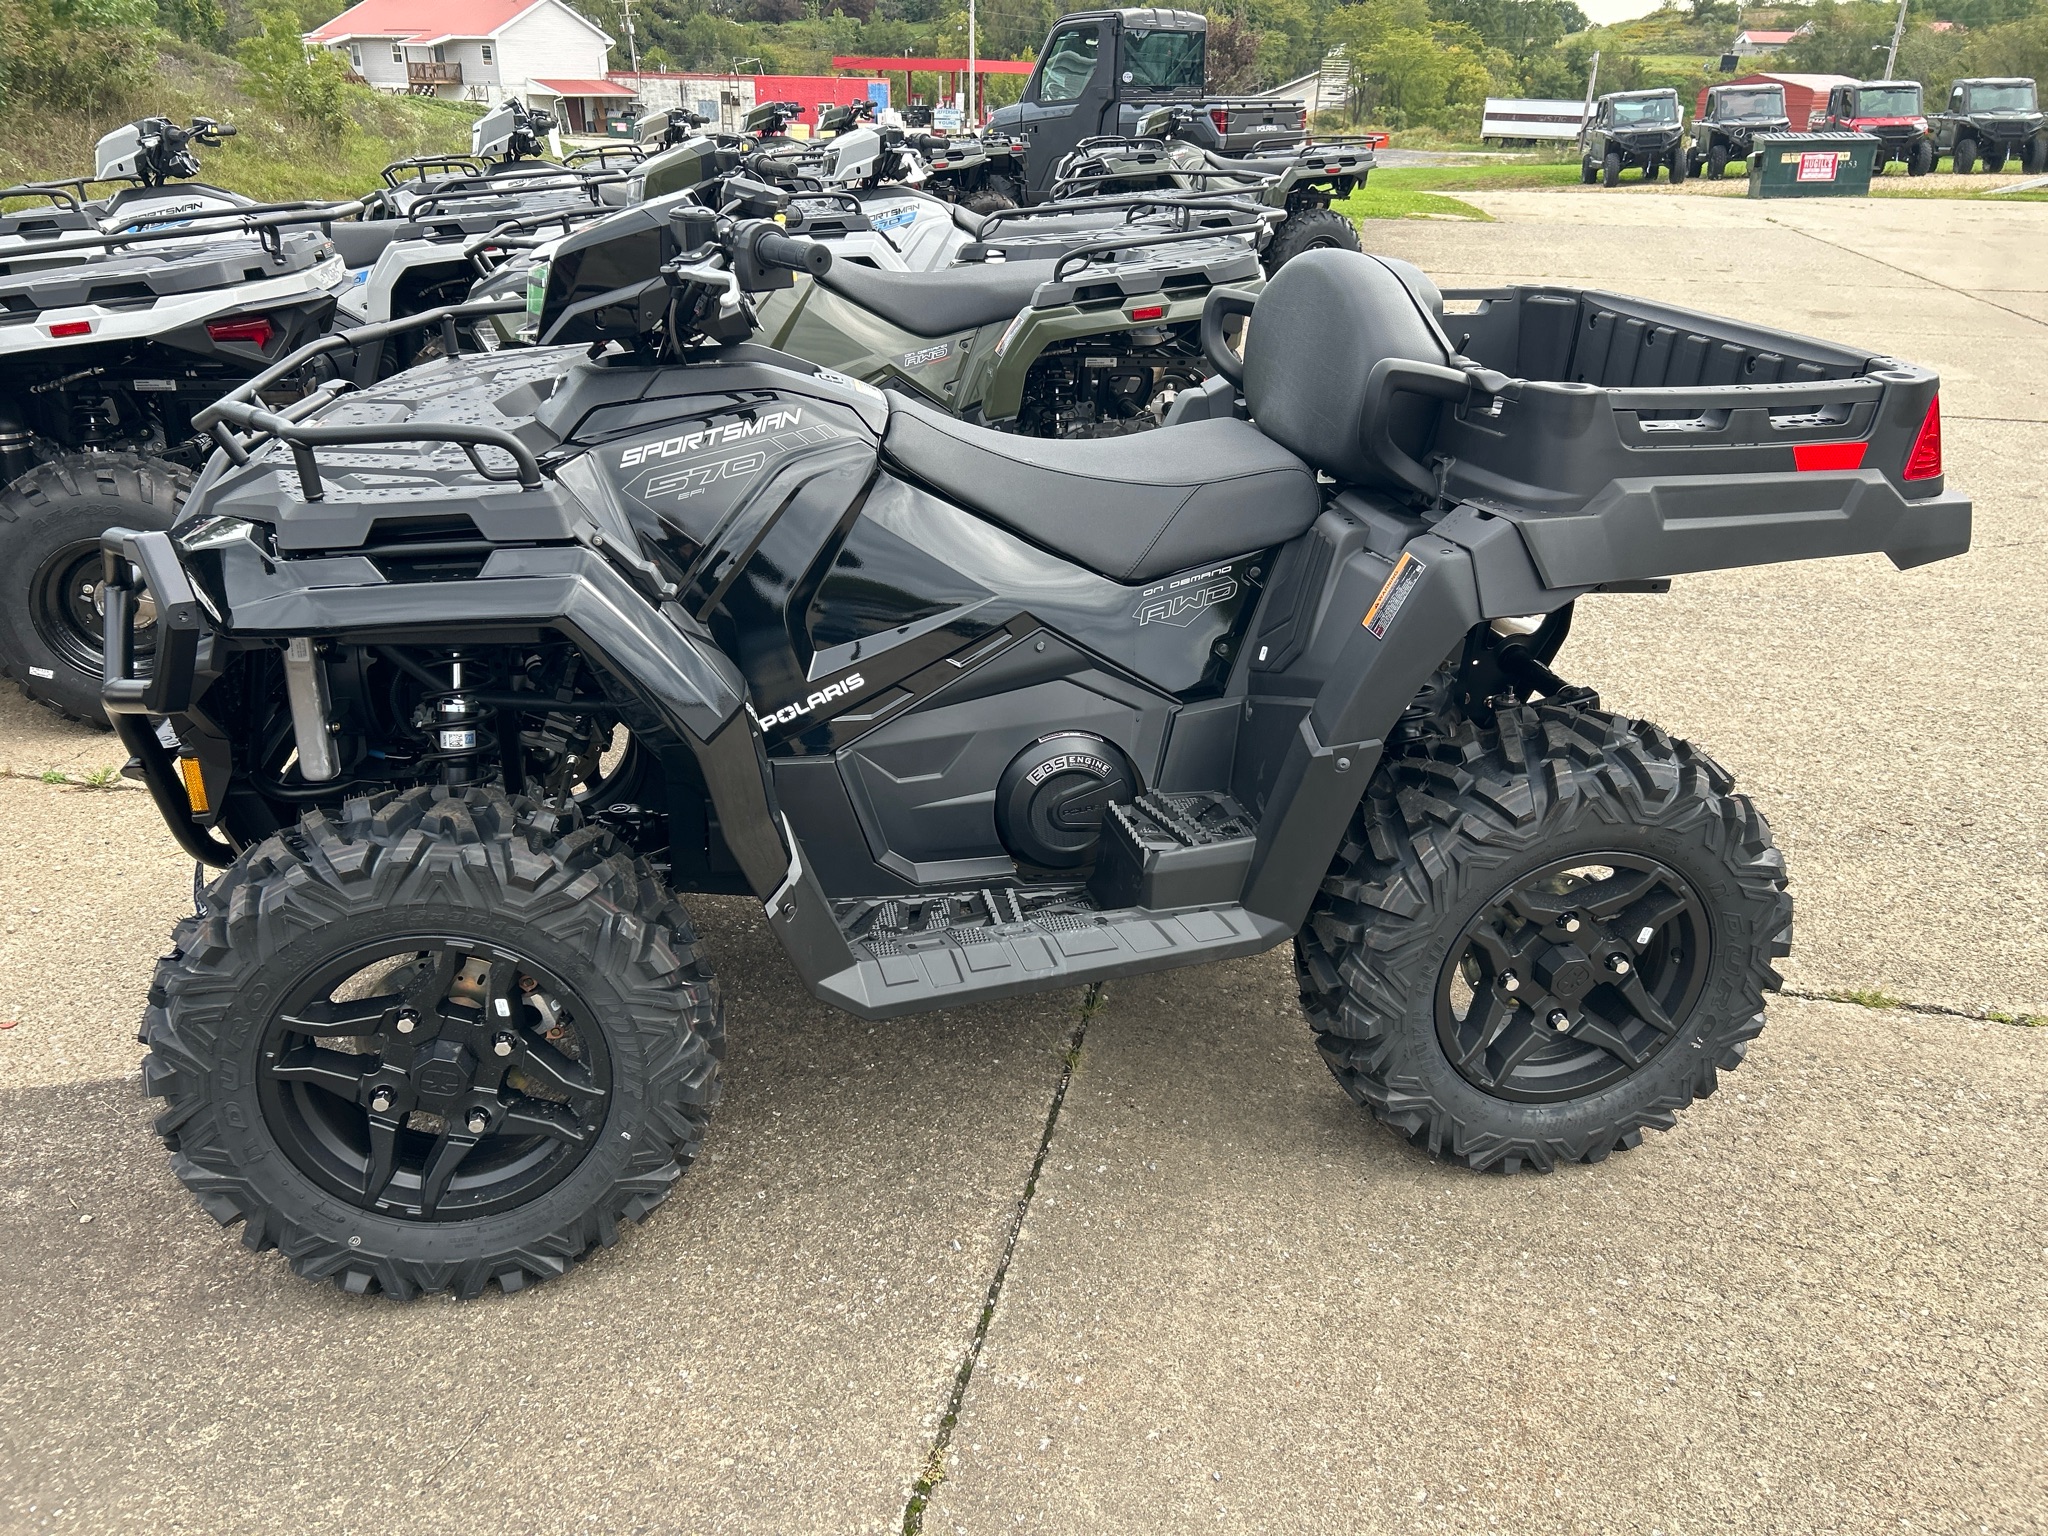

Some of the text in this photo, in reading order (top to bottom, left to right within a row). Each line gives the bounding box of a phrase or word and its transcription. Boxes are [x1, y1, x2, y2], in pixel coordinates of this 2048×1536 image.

[1256, 125, 1278, 133] POLARIS
[1838, 160, 1858, 169] 2153
[904, 347, 948, 367] AWD
[619, 408, 802, 469] SPORTSMAN
[645, 451, 766, 499] 570
[677, 487, 706, 500] EFI
[1377, 570, 1399, 601] WARNING
[1140, 580, 1238, 627] AWD
[759, 672, 865, 733] POLARIS
[1030, 756, 1110, 782] EBS ENGINE
[1694, 911, 1743, 1041] DURO
